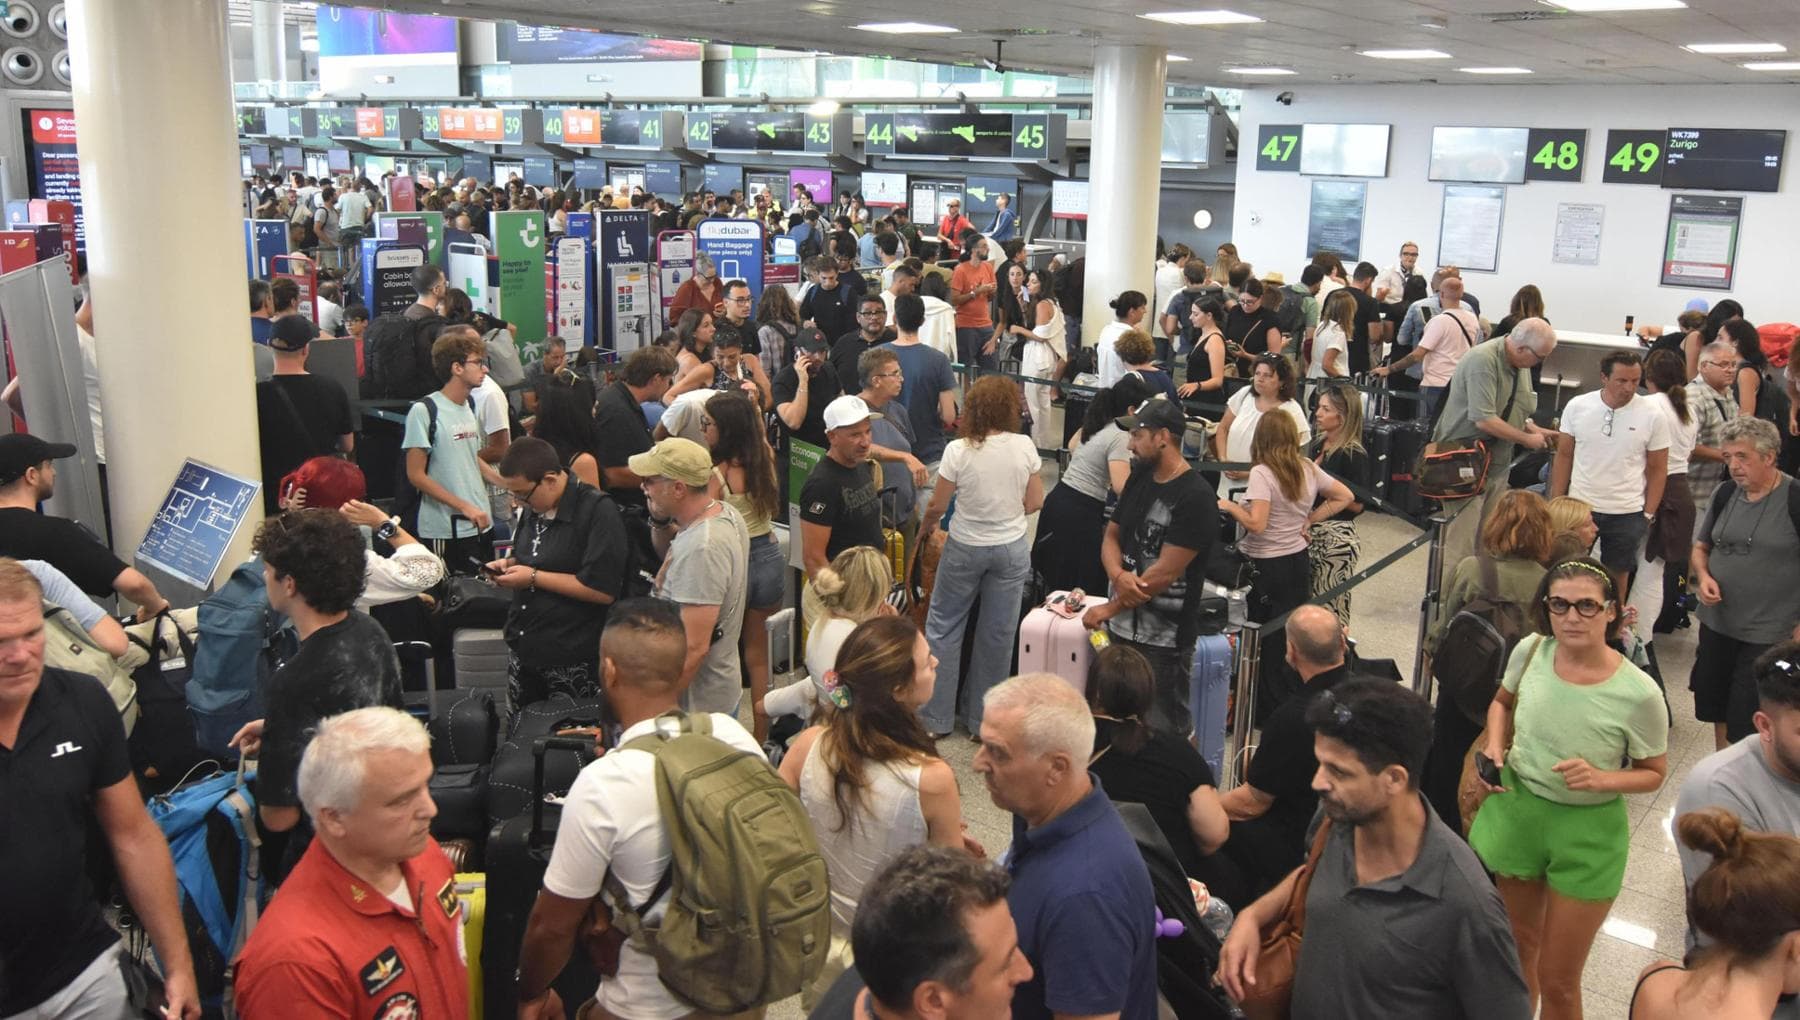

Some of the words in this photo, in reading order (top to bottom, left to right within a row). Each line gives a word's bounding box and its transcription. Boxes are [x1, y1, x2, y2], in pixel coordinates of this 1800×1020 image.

[319, 114, 331, 130] 36
[386, 115, 397, 131] 37
[425, 115, 439, 132] 38
[505, 117, 520, 134] 39
[545, 118, 562, 135] 40
[643, 119, 659, 139] 41
[690, 121, 709, 141] 42
[807, 122, 830, 144] 43
[867, 123, 893, 145] 44
[1016, 125, 1044, 149] 45
[1261, 135, 1298, 162] 47
[1670, 139, 1698, 150] Zurigo
[1532, 141, 1579, 171] 48
[1609, 142, 1660, 173] 49
[725, 242, 753, 250] Baggage
[383, 272, 404, 280] Cabin
[791, 442, 821, 463] Economy
[791, 456, 808, 470] Class
